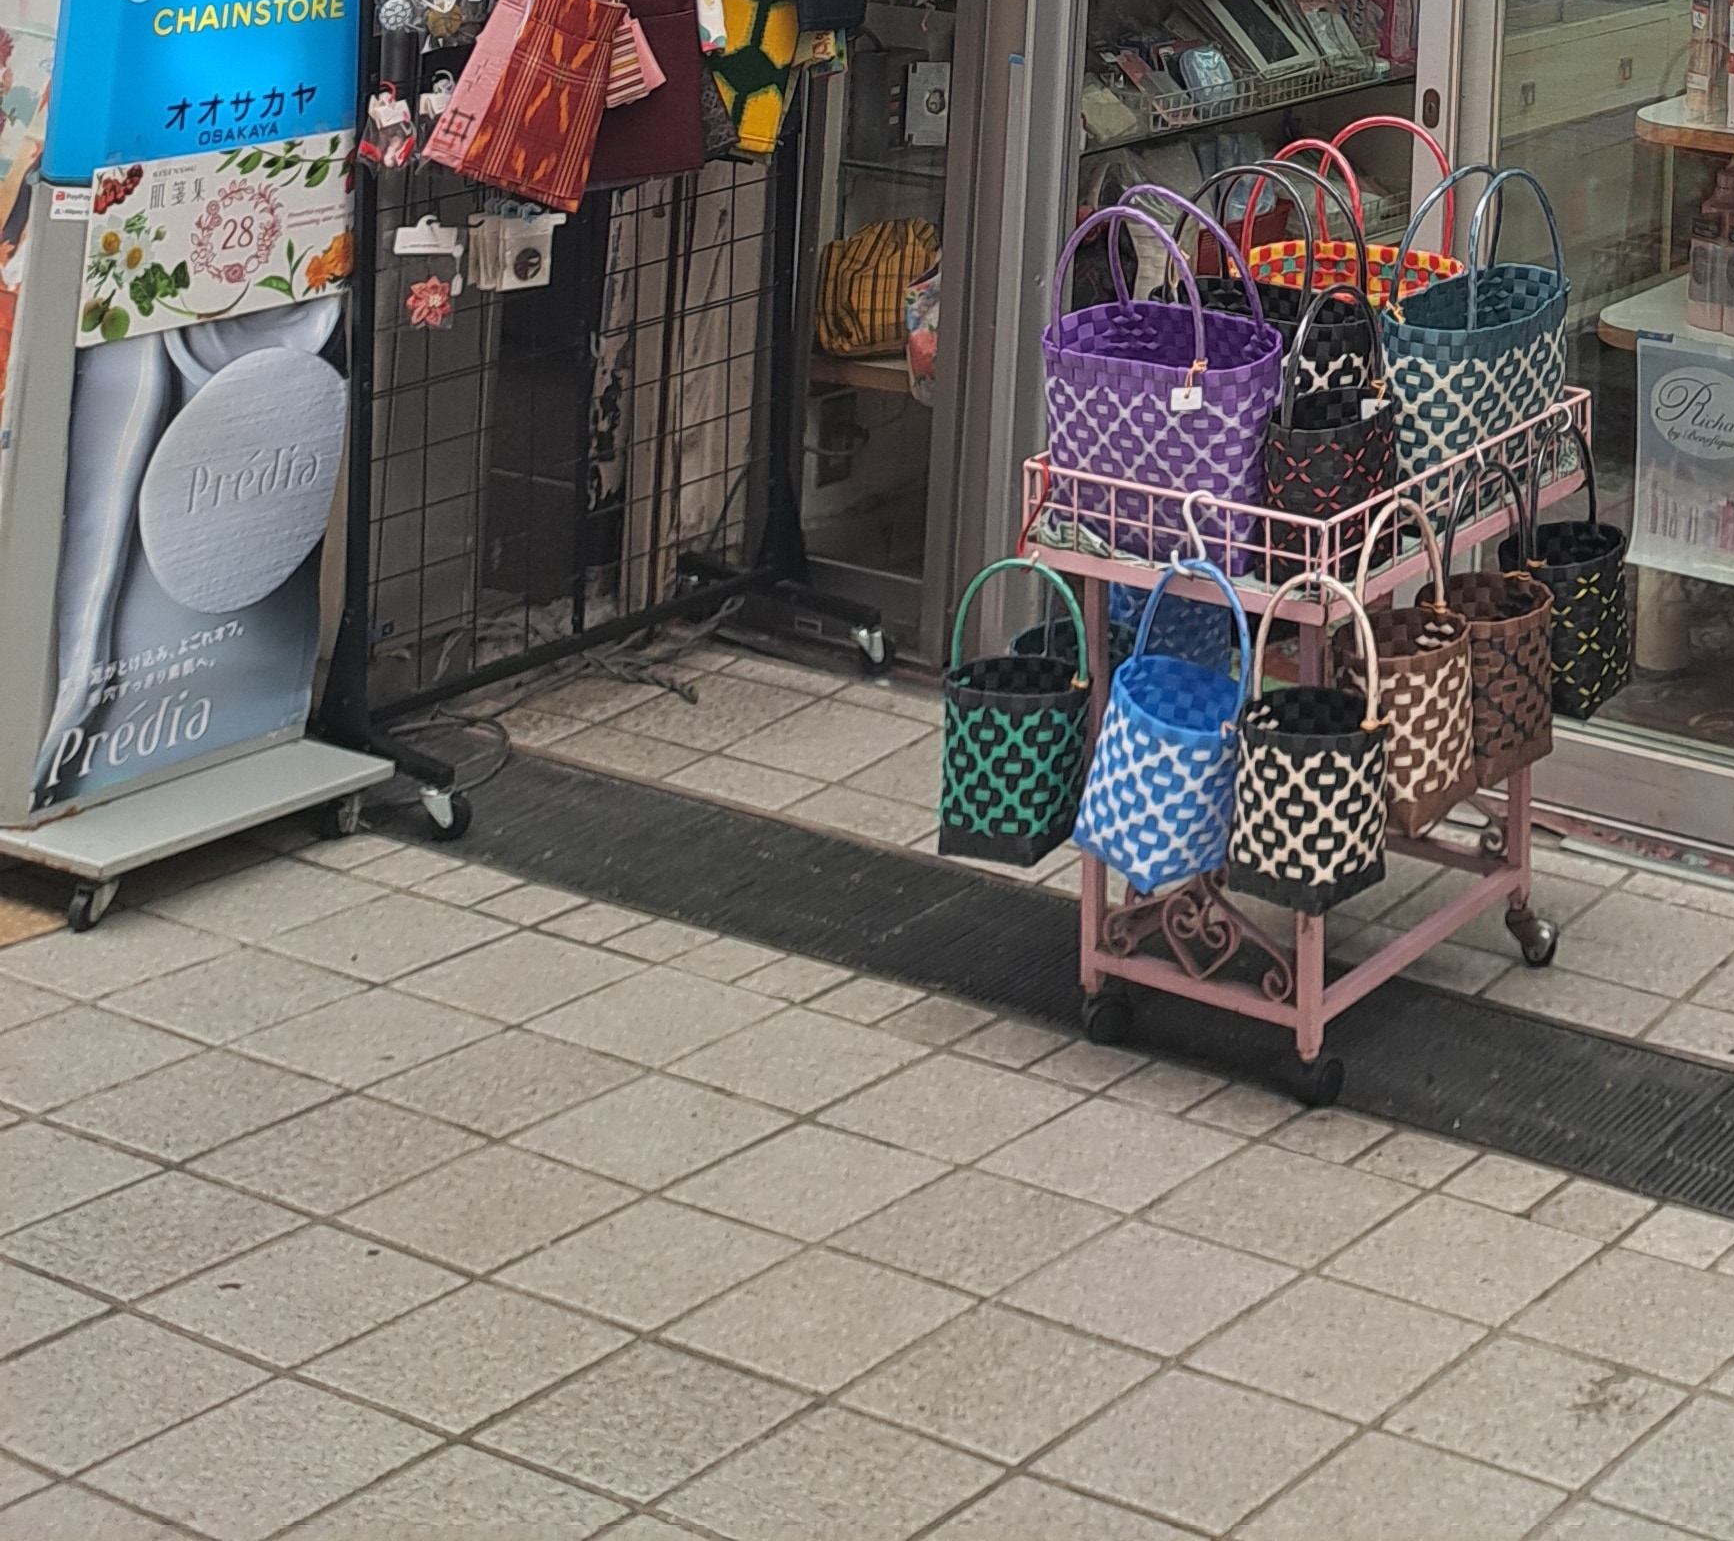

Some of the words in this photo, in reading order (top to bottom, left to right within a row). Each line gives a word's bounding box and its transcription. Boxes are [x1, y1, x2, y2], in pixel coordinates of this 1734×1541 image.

[165, 83, 317, 130] オオサカヤ
[199, 122, 279, 146] OSAKAYA
[222, 216, 254, 250] 28
[187, 442, 322, 516] Prédia
[45, 689, 212, 789] Prédia
